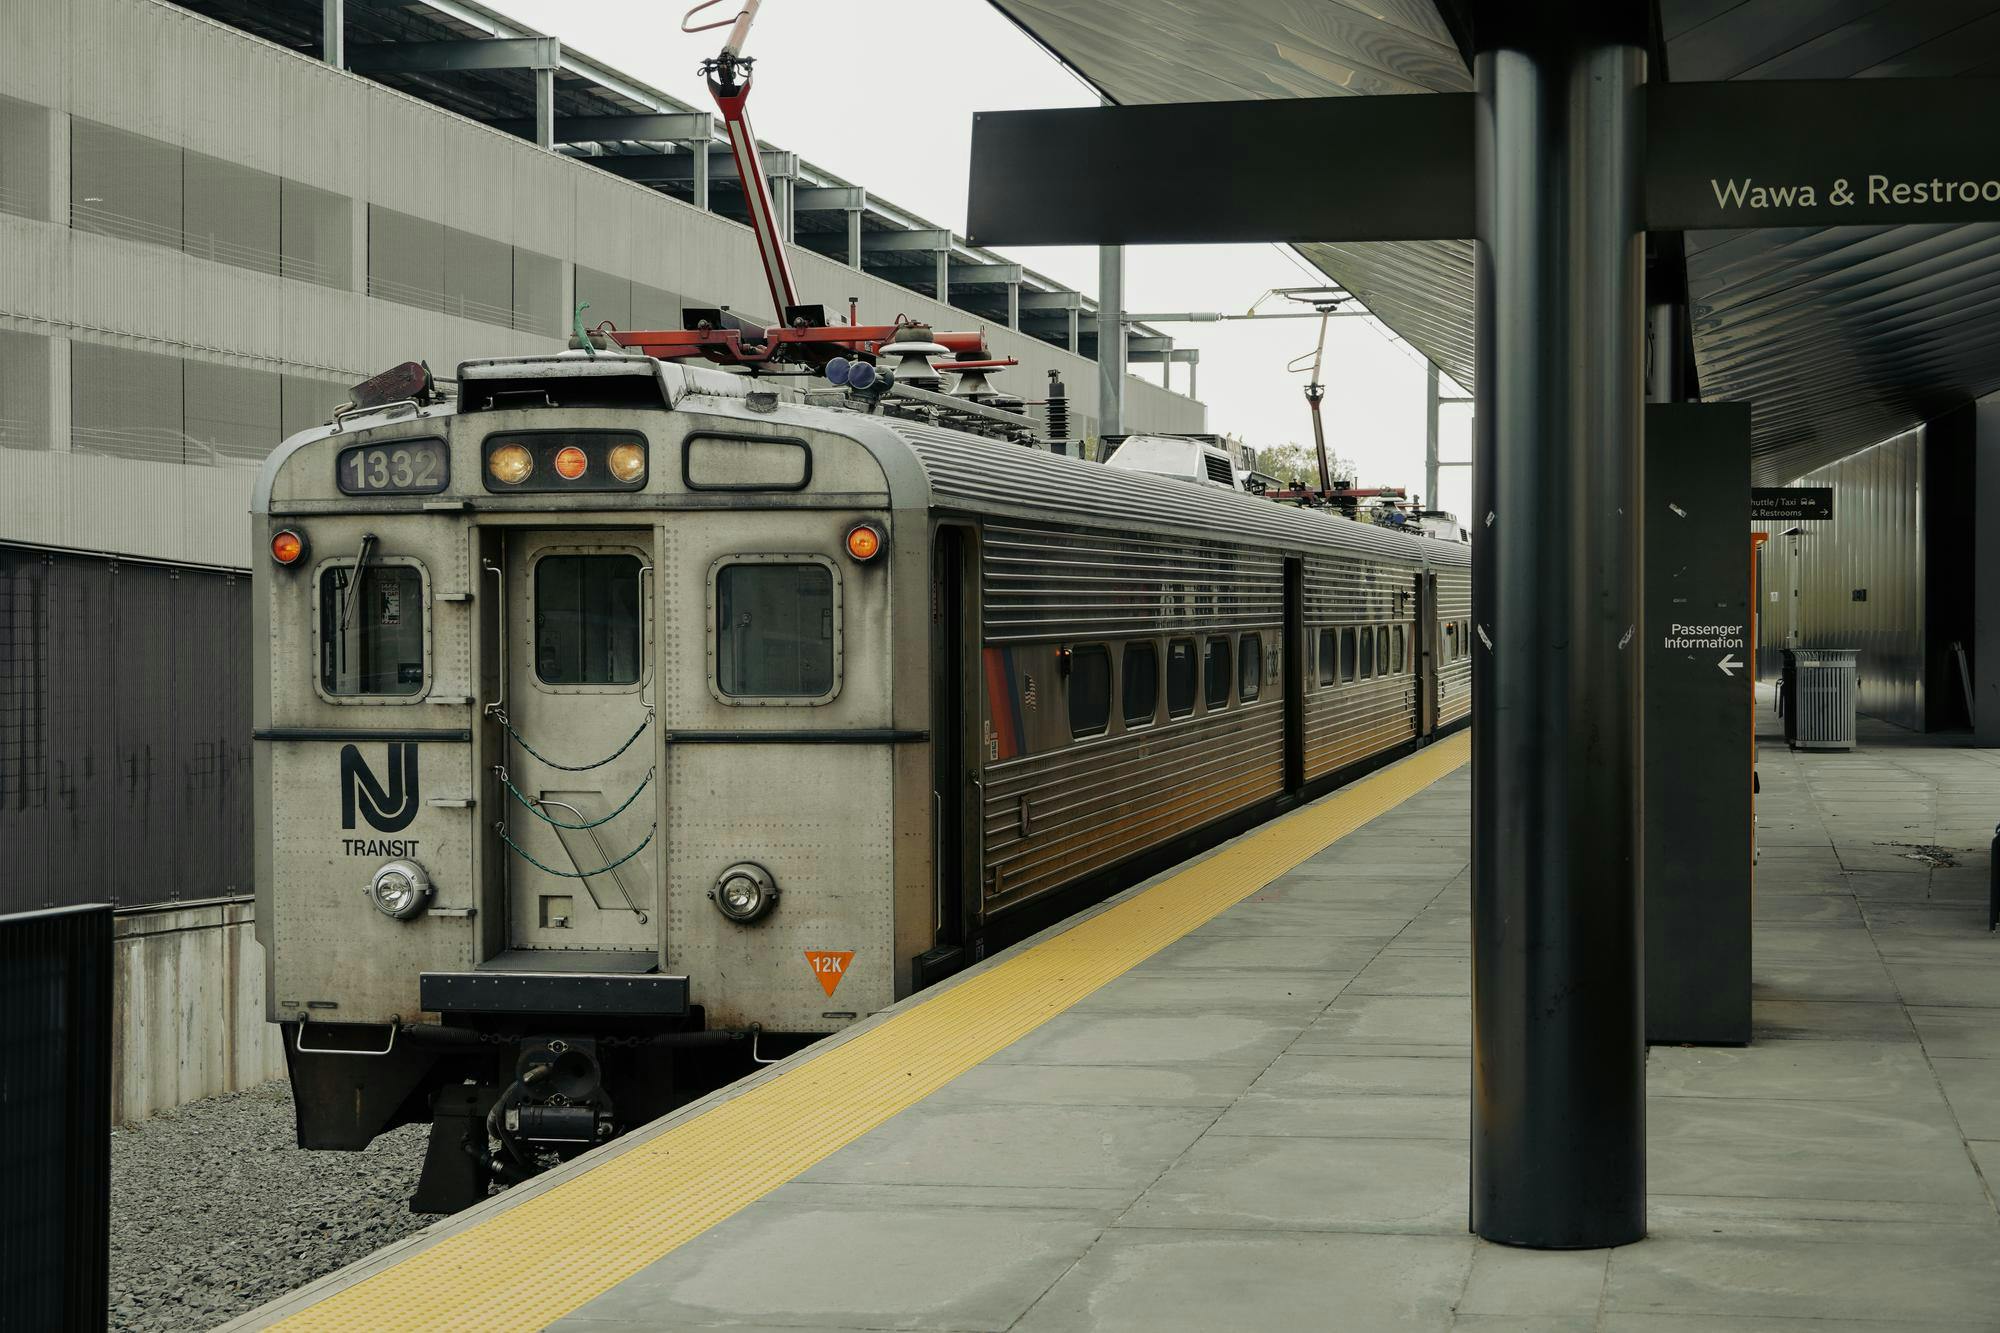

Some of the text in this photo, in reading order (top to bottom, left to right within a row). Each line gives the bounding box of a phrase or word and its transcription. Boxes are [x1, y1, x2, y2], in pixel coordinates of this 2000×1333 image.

[1711, 175, 2000, 209] Wawa & Restroo
[350, 450, 438, 489] 1332
[1781, 498, 1797, 506] Taxi
[1760, 508, 1802, 517] Restrooms
[1671, 623, 1743, 637] Passenger
[1664, 636, 1744, 649] Information
[341, 742, 420, 833] NJ
[342, 839, 420, 857] TRANSIT
[813, 956, 843, 973] 12K
